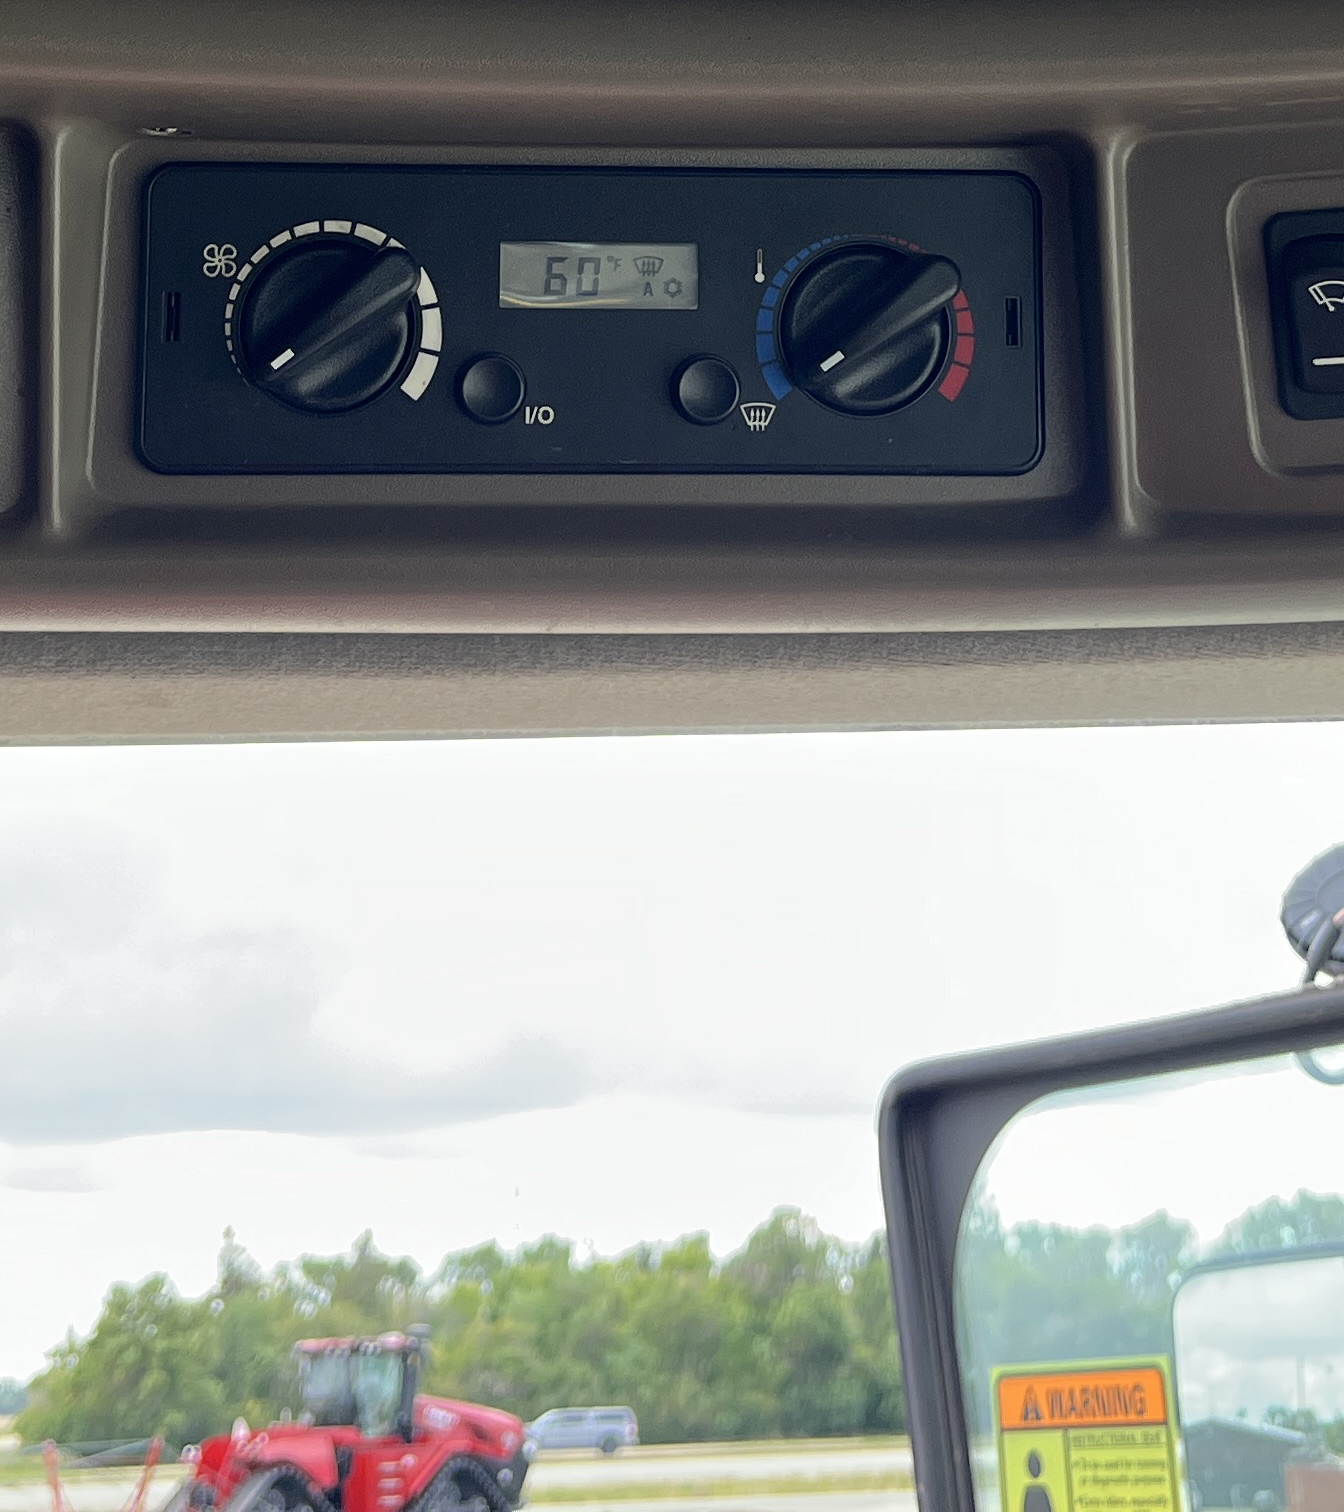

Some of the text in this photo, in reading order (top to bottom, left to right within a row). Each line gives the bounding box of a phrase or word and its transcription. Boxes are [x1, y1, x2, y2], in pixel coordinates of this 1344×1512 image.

[642, 281, 654, 297] A
[525, 406, 555, 425] I/O
[1045, 1383, 1147, 1419] WARNING
